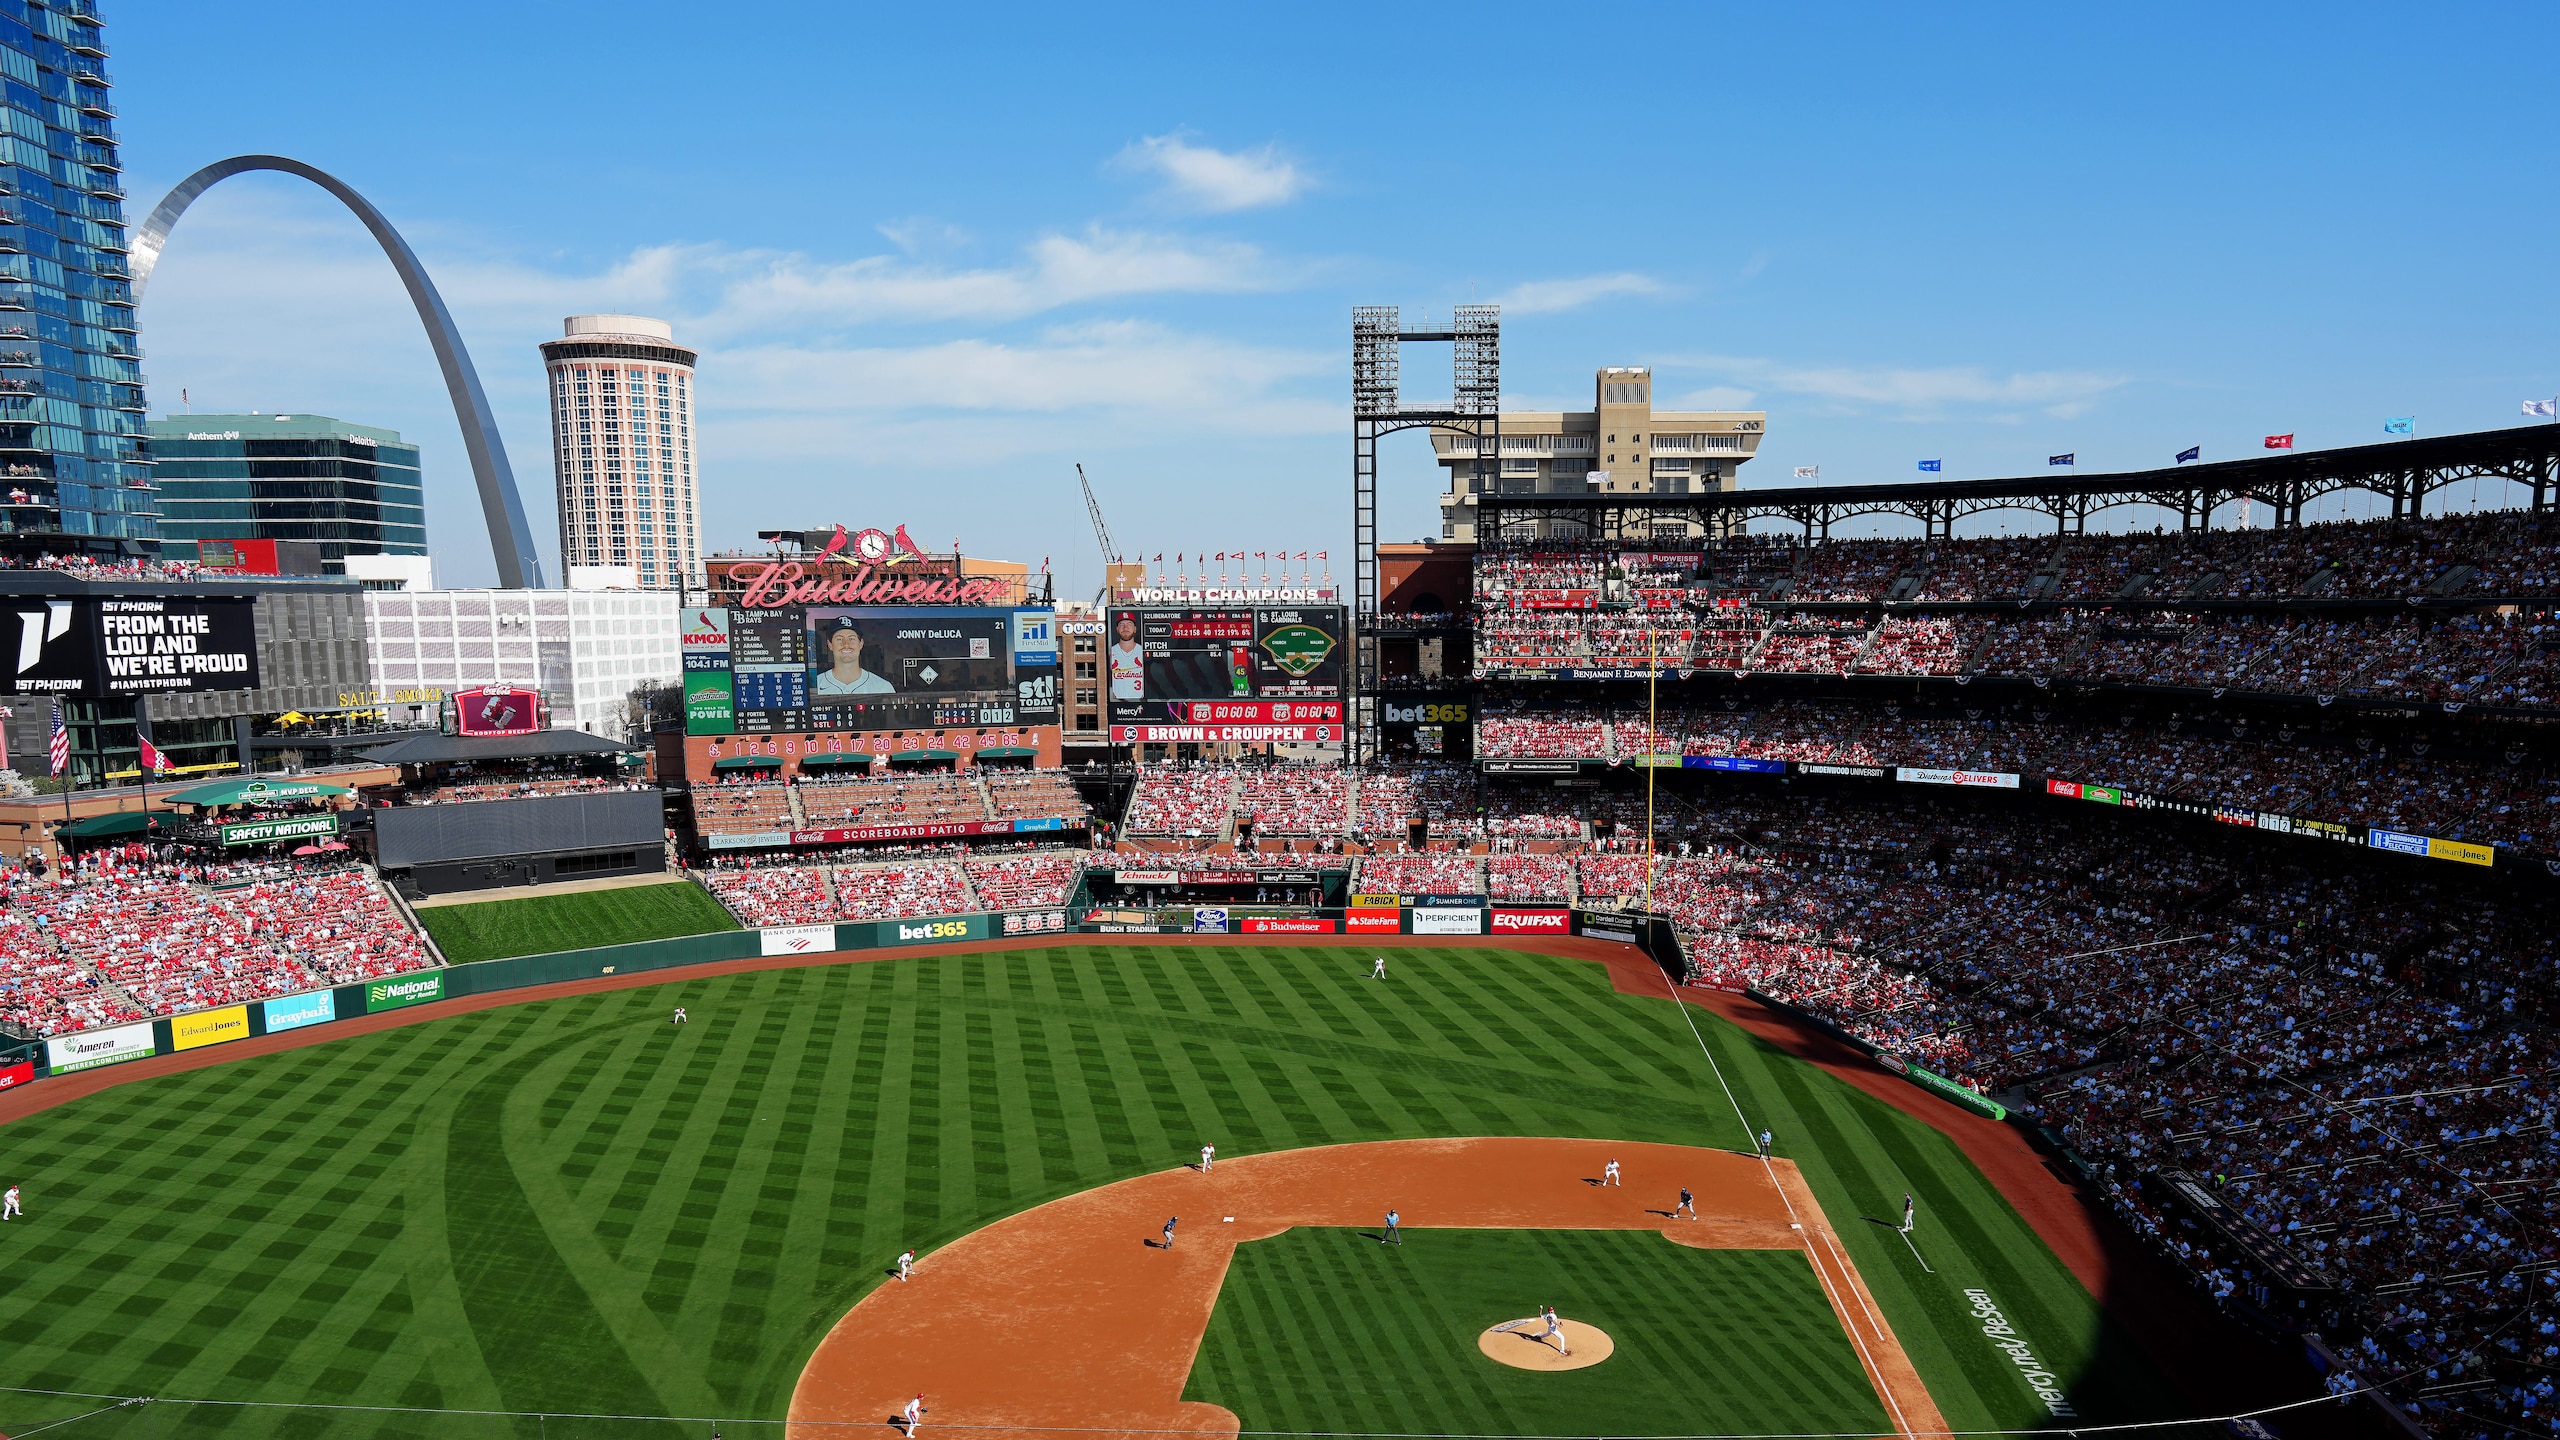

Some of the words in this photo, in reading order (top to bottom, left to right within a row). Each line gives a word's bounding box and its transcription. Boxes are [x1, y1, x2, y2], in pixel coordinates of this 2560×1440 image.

[188, 432, 223, 441] Anthem
[1652, 554, 1699, 563] BUDWEISER
[729, 562, 1012, 608] Budweiser
[1131, 588, 1200, 602] WORLD
[1206, 588, 1318, 602] CHAMPIONS
[102, 601, 118, 612] 1ST
[120, 601, 164, 612] PHORM
[102, 615, 165, 635] FROM
[168, 615, 209, 634] THE
[995, 622, 1004, 630] 21
[1064, 625, 1104, 633] TUMS
[683, 633, 727, 644] KMOX
[897, 630, 926, 639] JONNY
[928, 630, 962, 639] DeLUCA
[104, 635, 148, 656] LOU
[153, 635, 197, 655] AND
[1144, 642, 1168, 650] PITCH
[106, 655, 176, 676] WE'RE
[181, 654, 248, 674] PROUD
[686, 660, 710, 668] 104.1
[713, 660, 728, 668] FM
[1236, 668, 1245, 676] 45
[1573, 670, 1613, 680] BENJAMIN
[1614, 670, 1622, 678] F.
[15, 680, 35, 690] 1ST
[35, 679, 82, 690] PHORM
[110, 677, 191, 690] #IAM1STPHORM
[1019, 675, 1054, 699] stl
[339, 691, 379, 707] SALT
[395, 688, 444, 704] SMOKE
[483, 686, 511, 697] Coca-Cola
[688, 691, 729, 704] Spectracide
[1020, 698, 1054, 706] TODAY
[690, 710, 731, 720] POWER
[1116, 707, 1138, 716] Mercy
[1215, 706, 1228, 718] GO
[1230, 706, 1243, 718] GO
[1244, 706, 1257, 718] GO
[1275, 710, 1287, 718] 66
[1295, 706, 1308, 718] GO
[1309, 706, 1322, 718] GO
[1385, 703, 1468, 722] bet365
[1148, 727, 1204, 740] BROWN
[1208, 730, 1218, 740] &
[1222, 727, 1304, 740] CROUPPEN
[786, 740, 795, 754] 9
[804, 740, 818, 753] 10
[827, 739, 842, 753] 14
[850, 738, 865, 752] 17
[874, 738, 891, 752] 20
[902, 736, 919, 750] 23
[927, 736, 944, 749] 24
[953, 735, 970, 748] 42
[979, 734, 997, 748] 45
[1002, 734, 1019, 747] 85
[735, 742, 741, 756] 1
[750, 742, 759, 755] 2
[767, 741, 777, 755] 6
[1490, 763, 1506, 771] Mercy
[1809, 764, 1850, 776] LINDENWOOD
[1850, 768, 1884, 778] UNIVERSITY
[1917, 771, 1952, 780] Dierbergs
[281, 788, 298, 796] MVP
[299, 786, 319, 795] DECK
[2054, 781, 2076, 796] Coca-Cola
[229, 826, 273, 841] SAFETY
[275, 820, 332, 836] NATIONAL
[795, 831, 825, 843] Coca-Cola
[843, 827, 925, 840] SCOREBOARD
[930, 824, 966, 835] PATIO
[980, 821, 1010, 834] Coca-Cola
[2296, 818, 2302, 827] 21
[2303, 820, 2323, 831] JONNY
[2324, 822, 2348, 834] DELUCA
[758, 835, 787, 844] JEWELERS
[2301, 828, 2316, 838] 1.000
[2389, 834, 2424, 845] REINHOLD
[2388, 843, 2415, 853] ELECTRIC
[2434, 844, 2462, 857] Edward
[2462, 848, 2486, 860] Jones
[1120, 872, 1172, 880] Schnucks
[1263, 874, 1278, 882] Mercy
[1363, 896, 1395, 905] FABICK
[1400, 896, 1415, 906] CAT
[1200, 910, 1220, 920] Ford
[1426, 914, 1479, 922] PERFICIENT
[1270, 921, 1320, 931] Budweiser
[1493, 914, 1564, 930] EQUIFAX
[798, 926, 832, 934] AMERICA
[899, 921, 967, 940] bet365
[405, 993, 416, 1001] Car
[418, 990, 437, 999] Rental
[181, 1025, 214, 1037] Edward
[214, 1019, 241, 1032] Jones
[76, 1039, 114, 1055] Ameren
[63, 1049, 146, 1072] AMEREN.COM/REBATES
